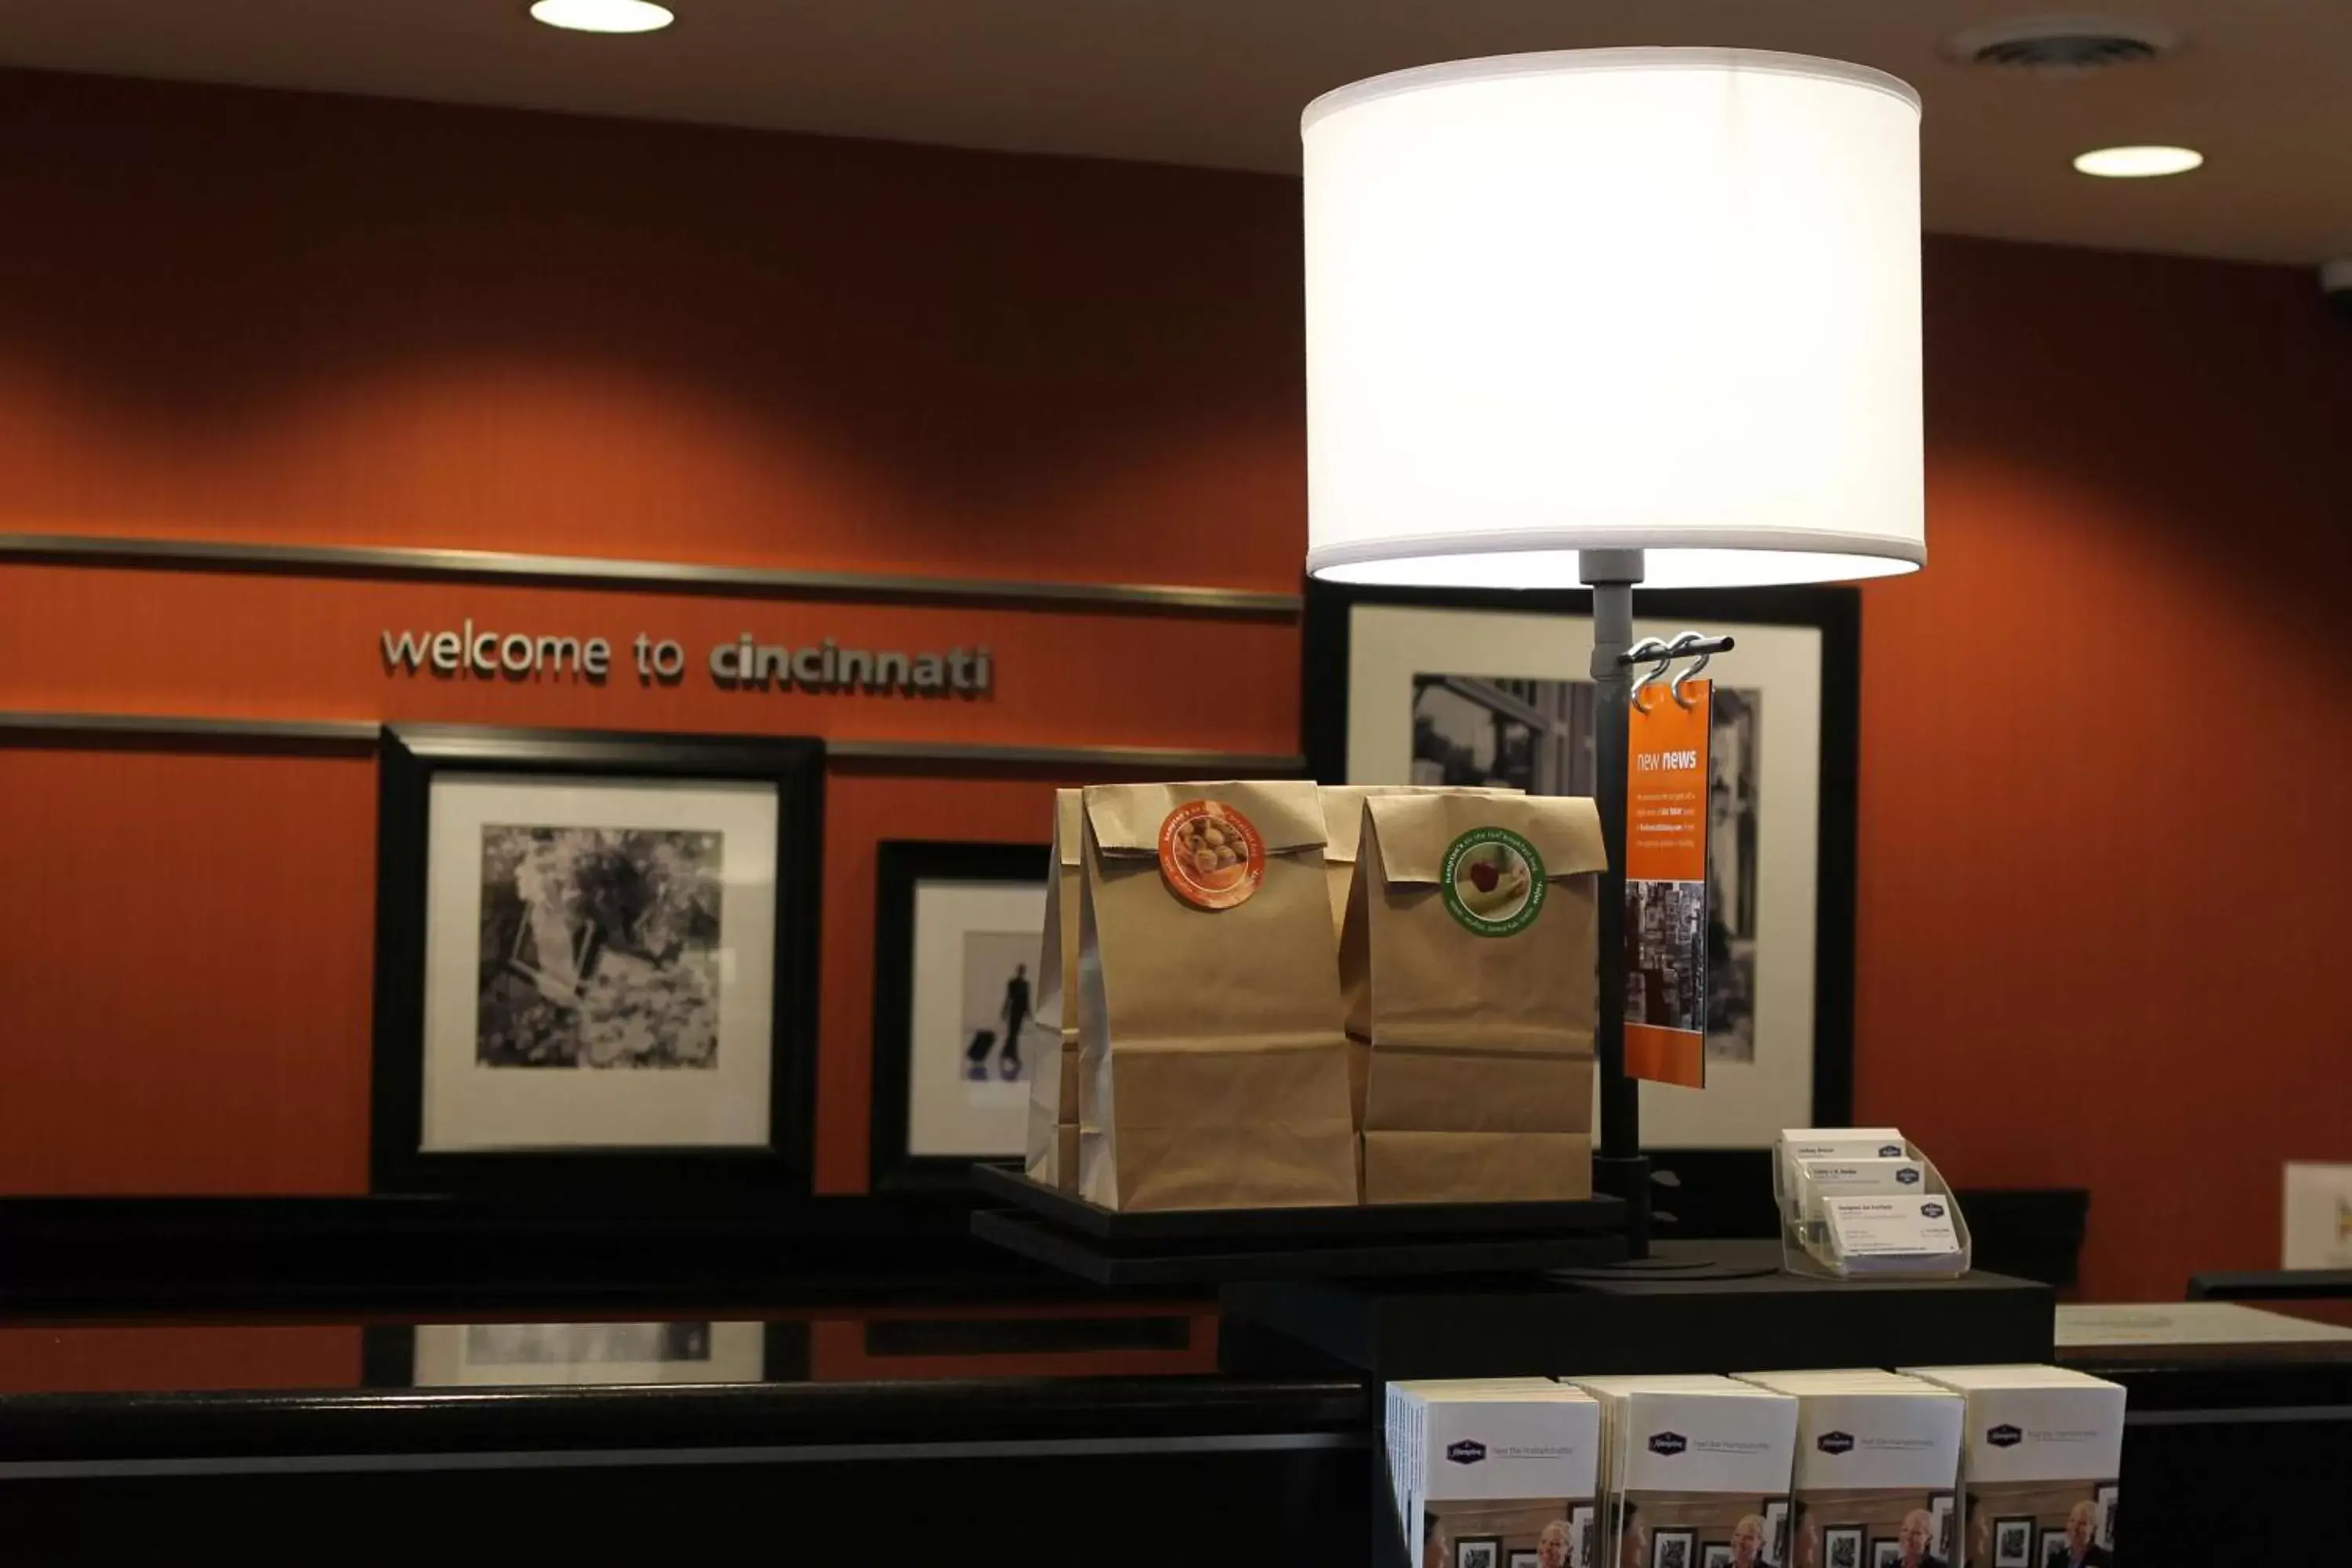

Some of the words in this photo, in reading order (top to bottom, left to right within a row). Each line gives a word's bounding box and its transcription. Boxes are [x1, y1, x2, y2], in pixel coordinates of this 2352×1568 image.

[381, 617, 612, 676] welcome
[634, 630, 684, 676] to
[709, 631, 992, 689] cincinnati
[1637, 752, 1661, 772] new
[1662, 749, 1697, 771] news
